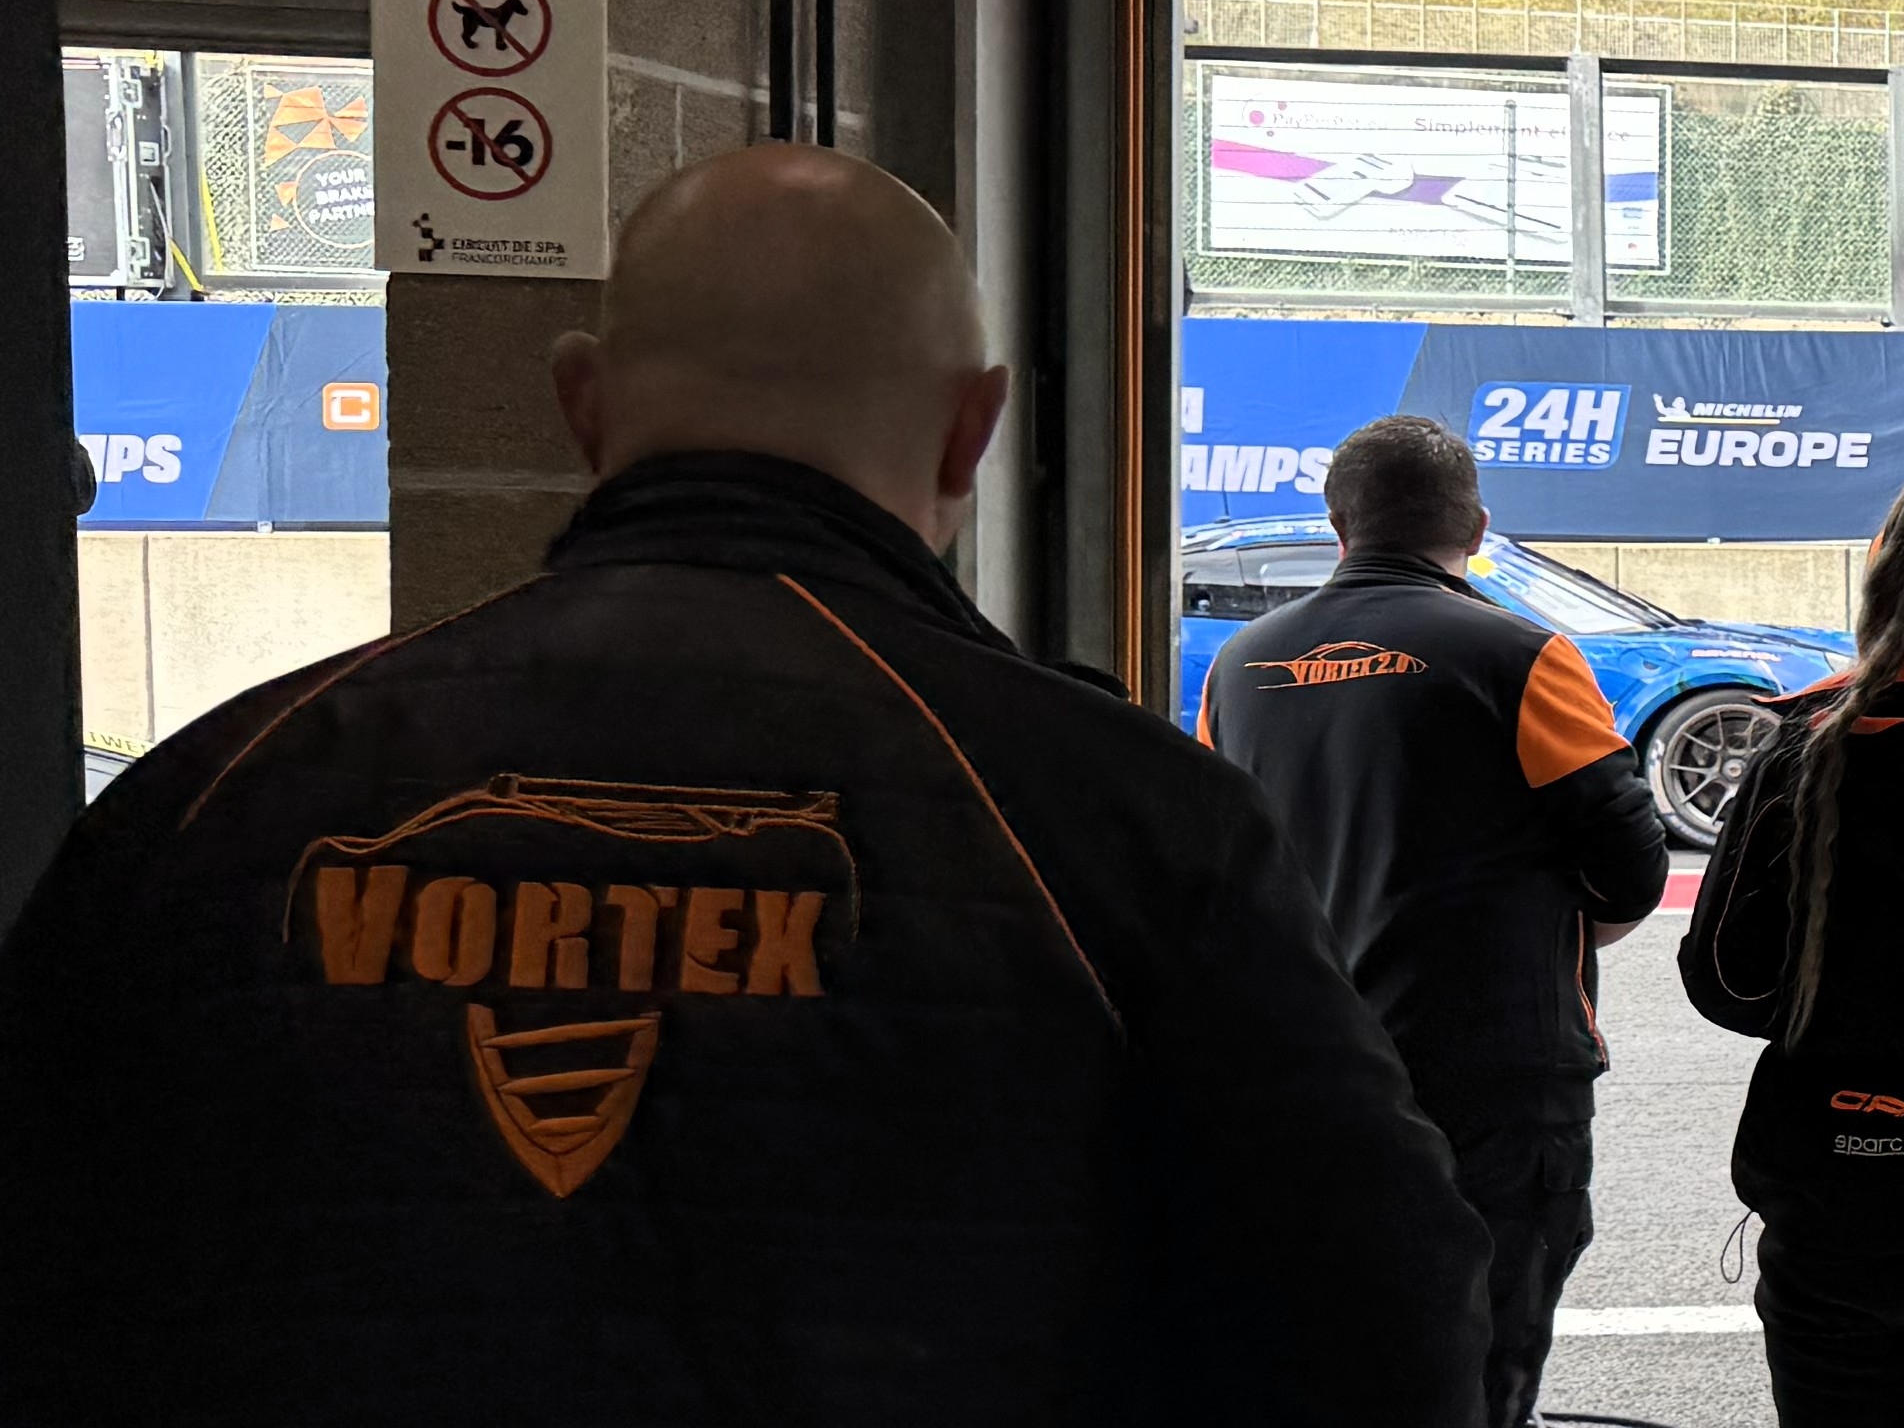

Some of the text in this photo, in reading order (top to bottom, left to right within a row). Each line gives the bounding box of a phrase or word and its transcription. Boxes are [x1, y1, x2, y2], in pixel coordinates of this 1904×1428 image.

[315, 167, 366, 188] YOUR
[1477, 388, 1622, 442] 24H
[1692, 403, 1803, 418] MICHELIN
[1473, 439, 1611, 465] SERIES
[1645, 429, 1873, 468] EUROPE
[315, 865, 827, 996] VORTEX
